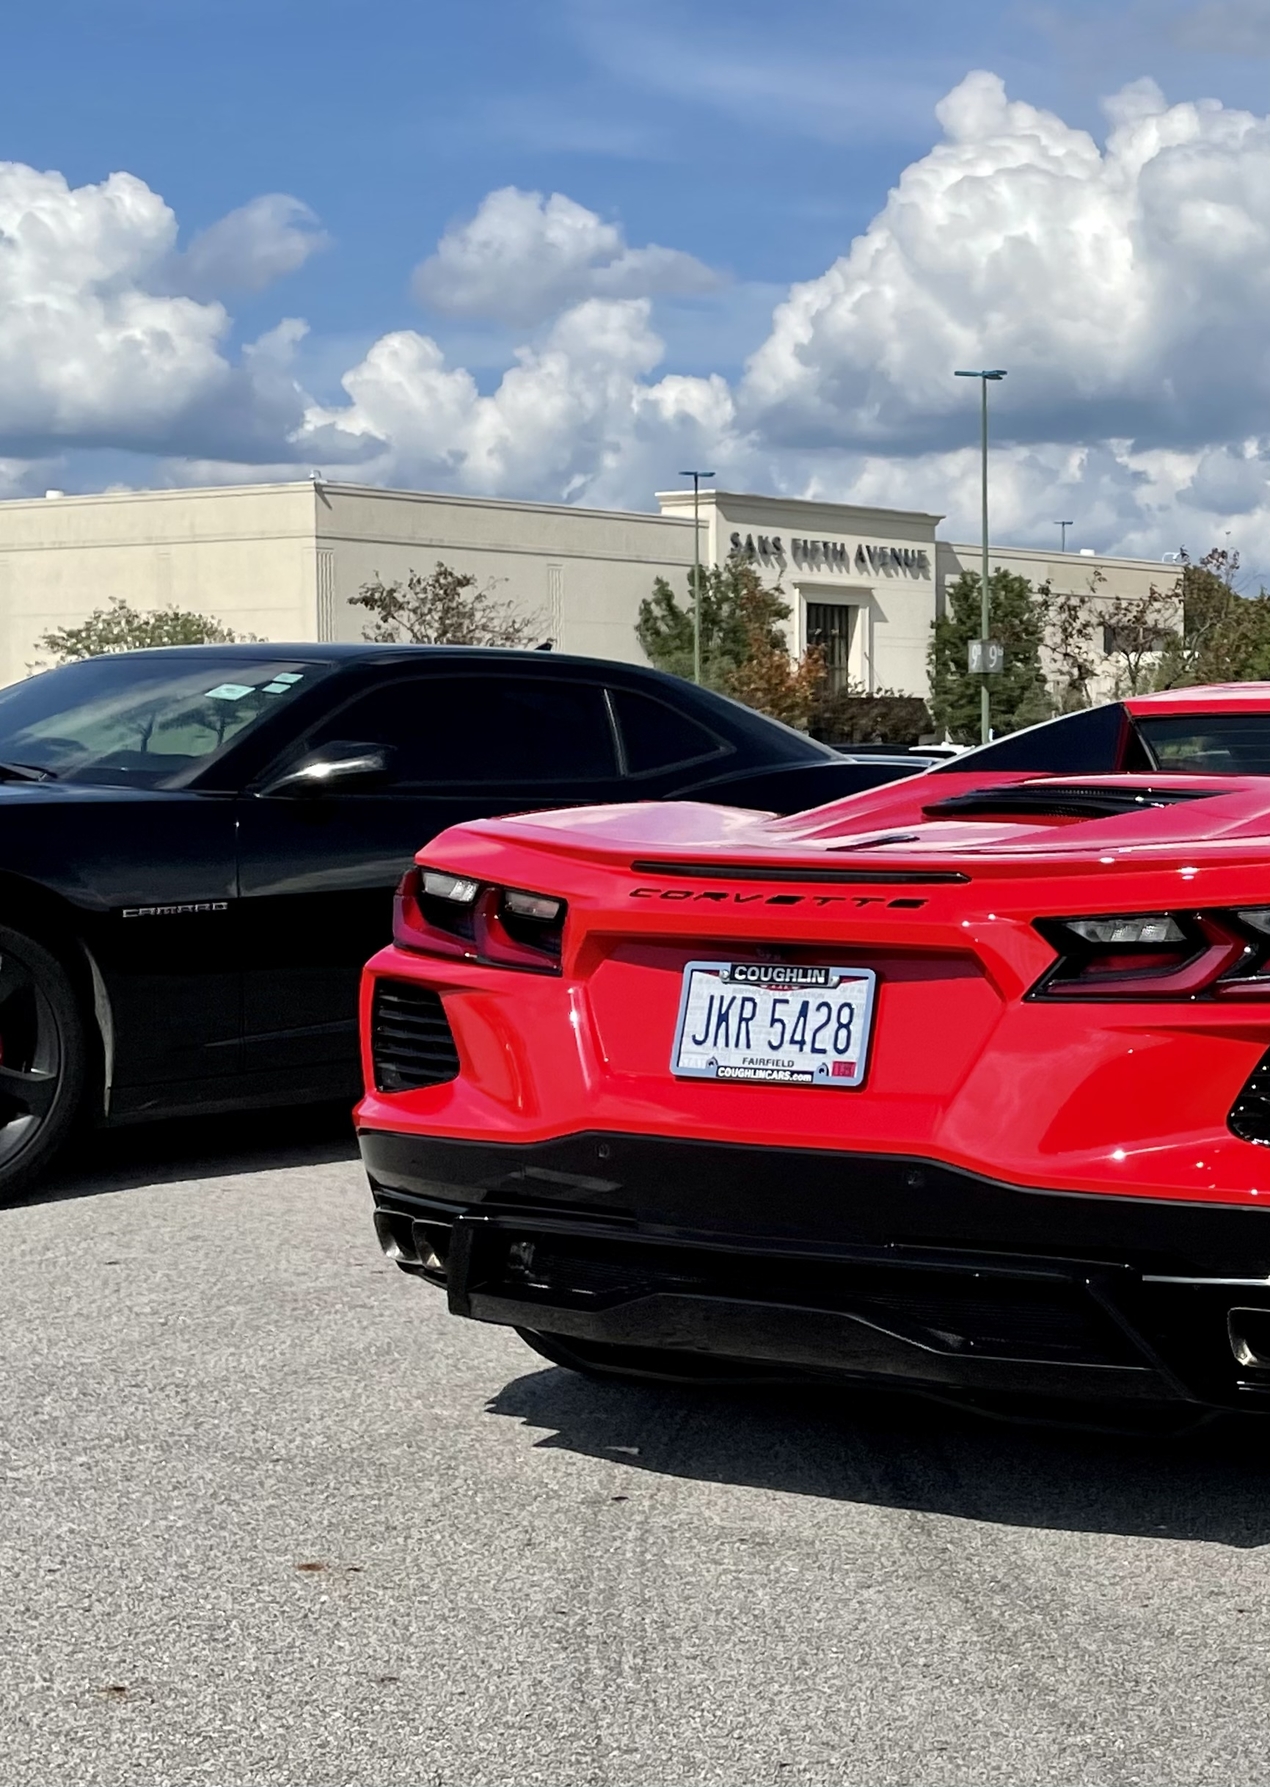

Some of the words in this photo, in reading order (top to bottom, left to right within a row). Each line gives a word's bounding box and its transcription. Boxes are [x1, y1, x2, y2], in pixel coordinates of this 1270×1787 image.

[730, 532, 786, 558] SAKS
[791, 537, 848, 563] FIFTH
[856, 543, 931, 571] AVENUE
[628, 887, 930, 909] CORVETTE
[122, 902, 228, 918] CAMARO
[734, 965, 826, 984] COUGHLIN
[692, 994, 758, 1050] JKR
[767, 998, 855, 1055] 5428
[742, 1056, 795, 1068] FAIRFIELD
[717, 1066, 812, 1082] COUGHLINCARS.com
